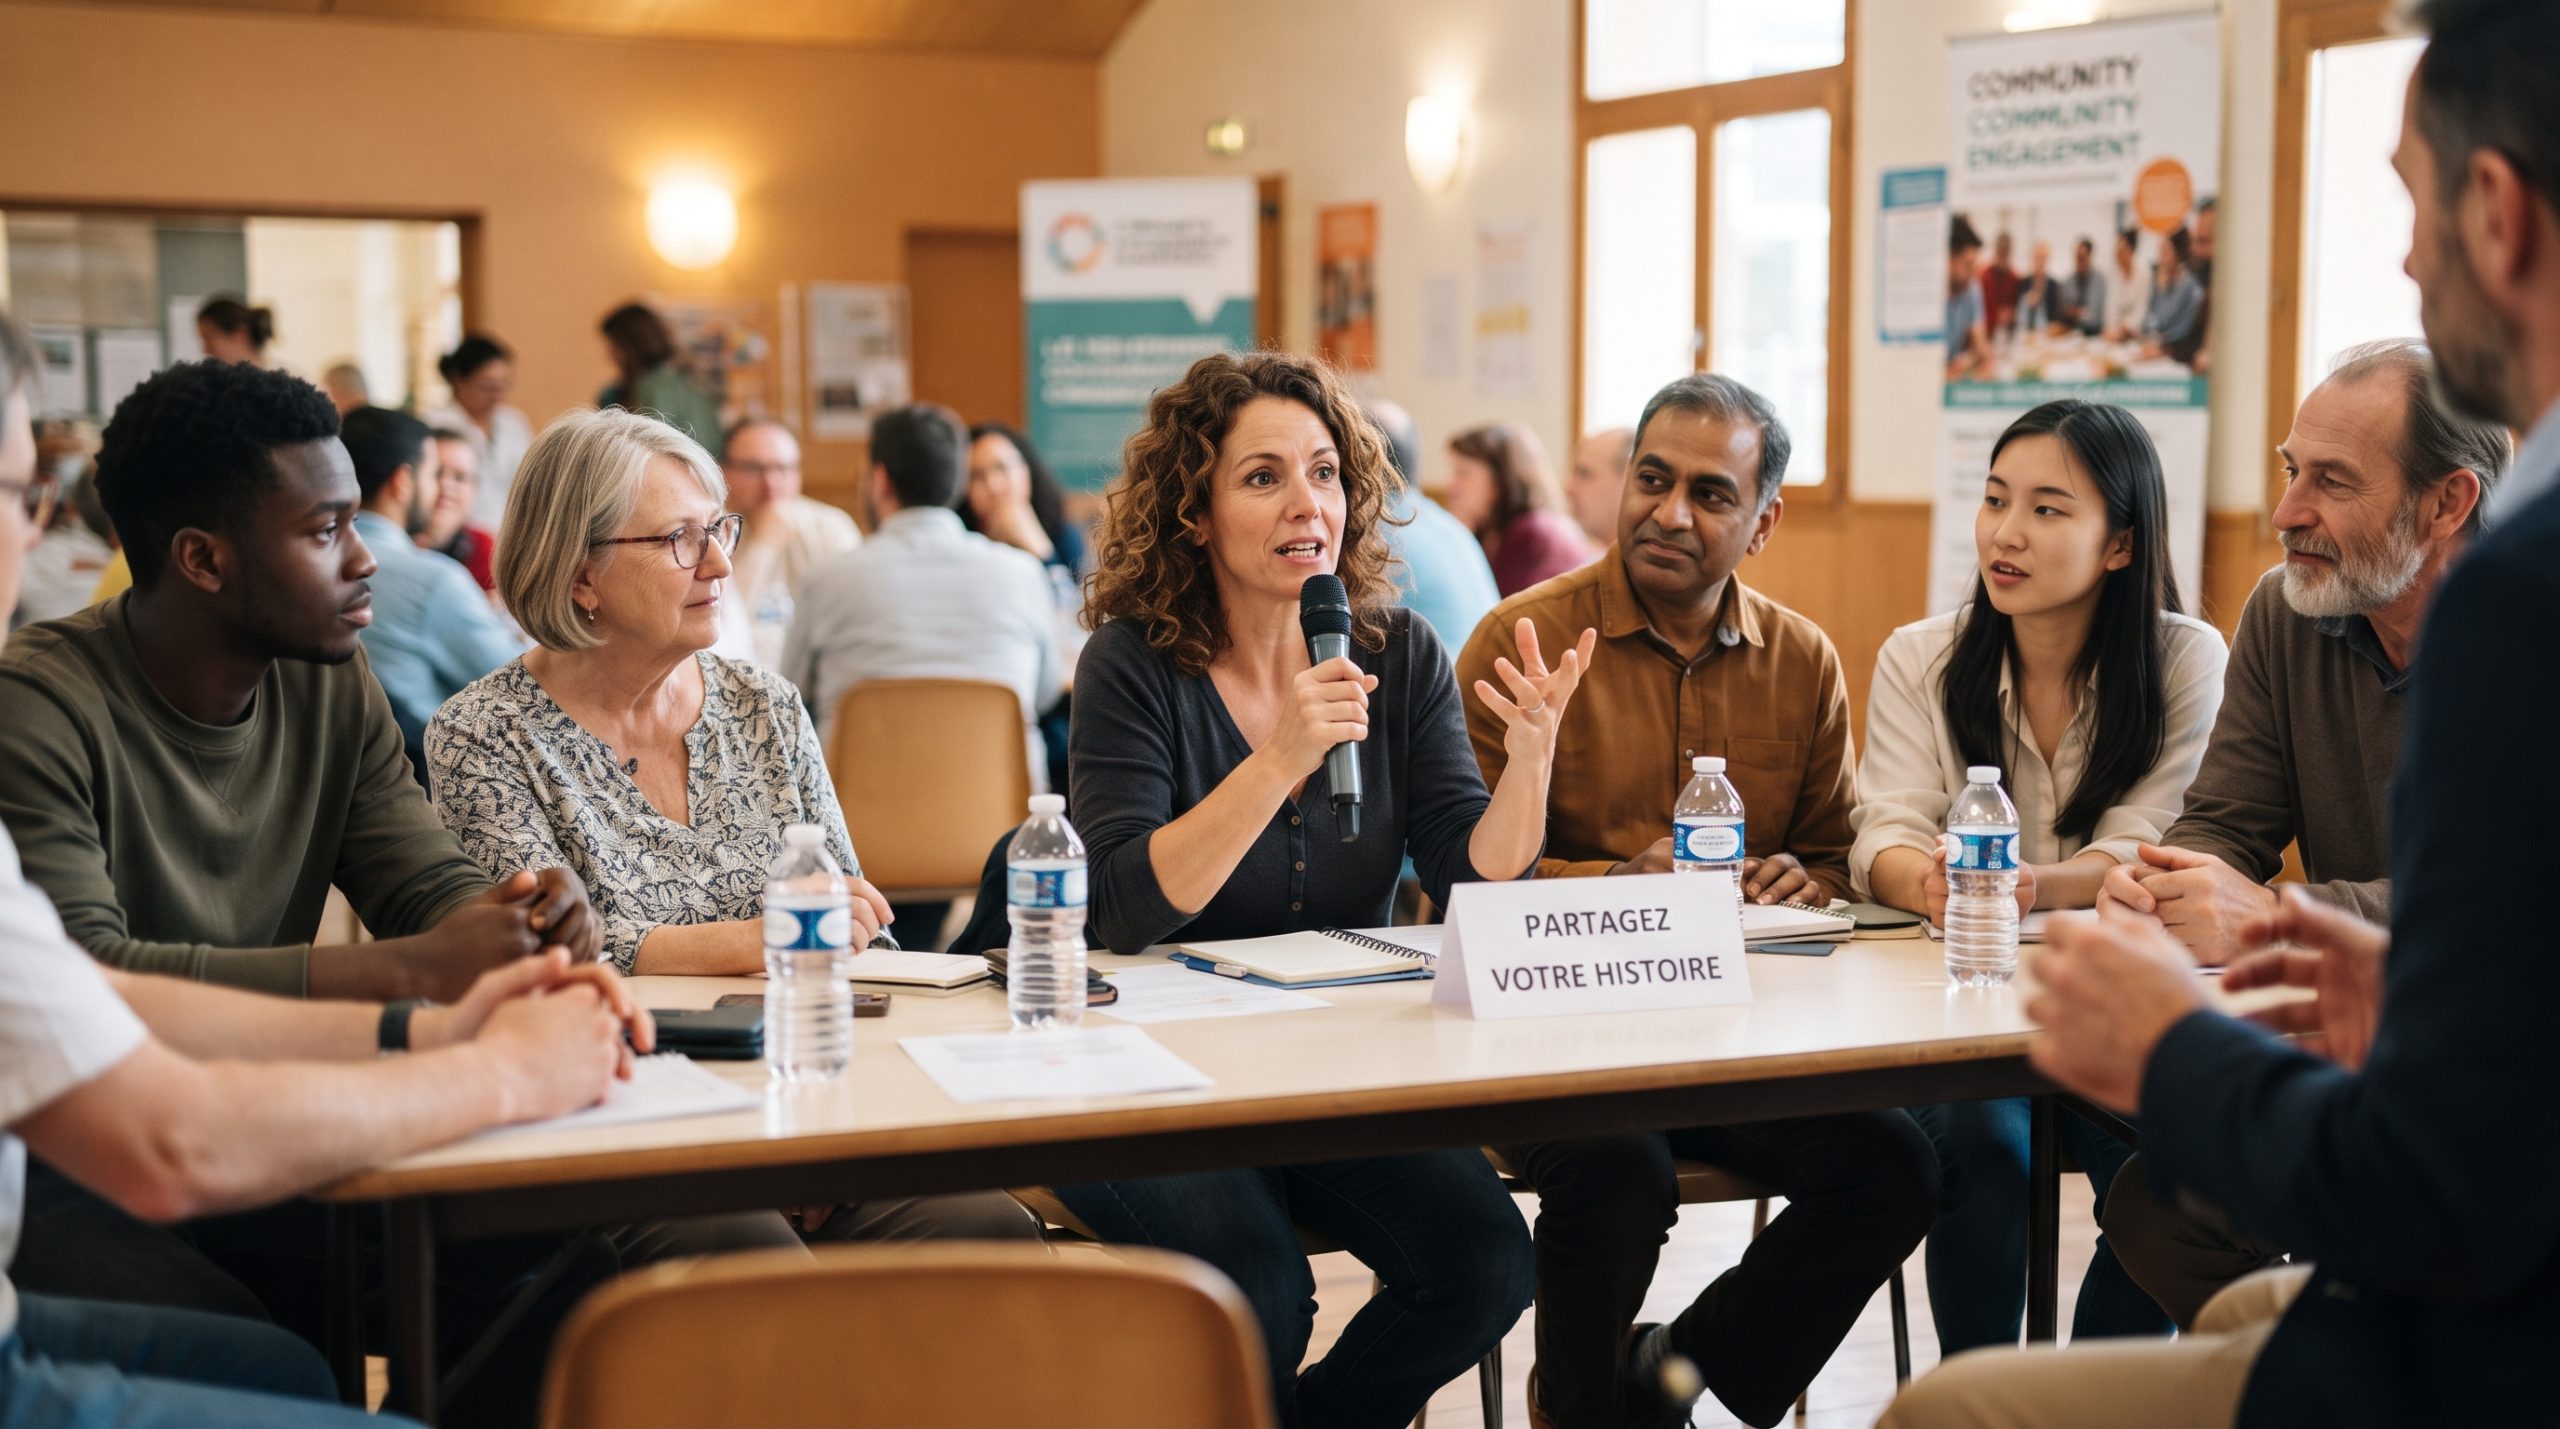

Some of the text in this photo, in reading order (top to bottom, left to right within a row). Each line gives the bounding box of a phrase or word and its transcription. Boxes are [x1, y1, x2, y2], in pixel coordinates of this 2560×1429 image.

[1968, 55, 2141, 99] COMMUNITY
[1968, 96, 2140, 135] COMMUNITY
[1968, 132, 2141, 171] ENGAGEMENT
[1525, 908, 1671, 938] PARTAGEZ
[1491, 956, 1723, 992] VOTRE HISTOIRE
